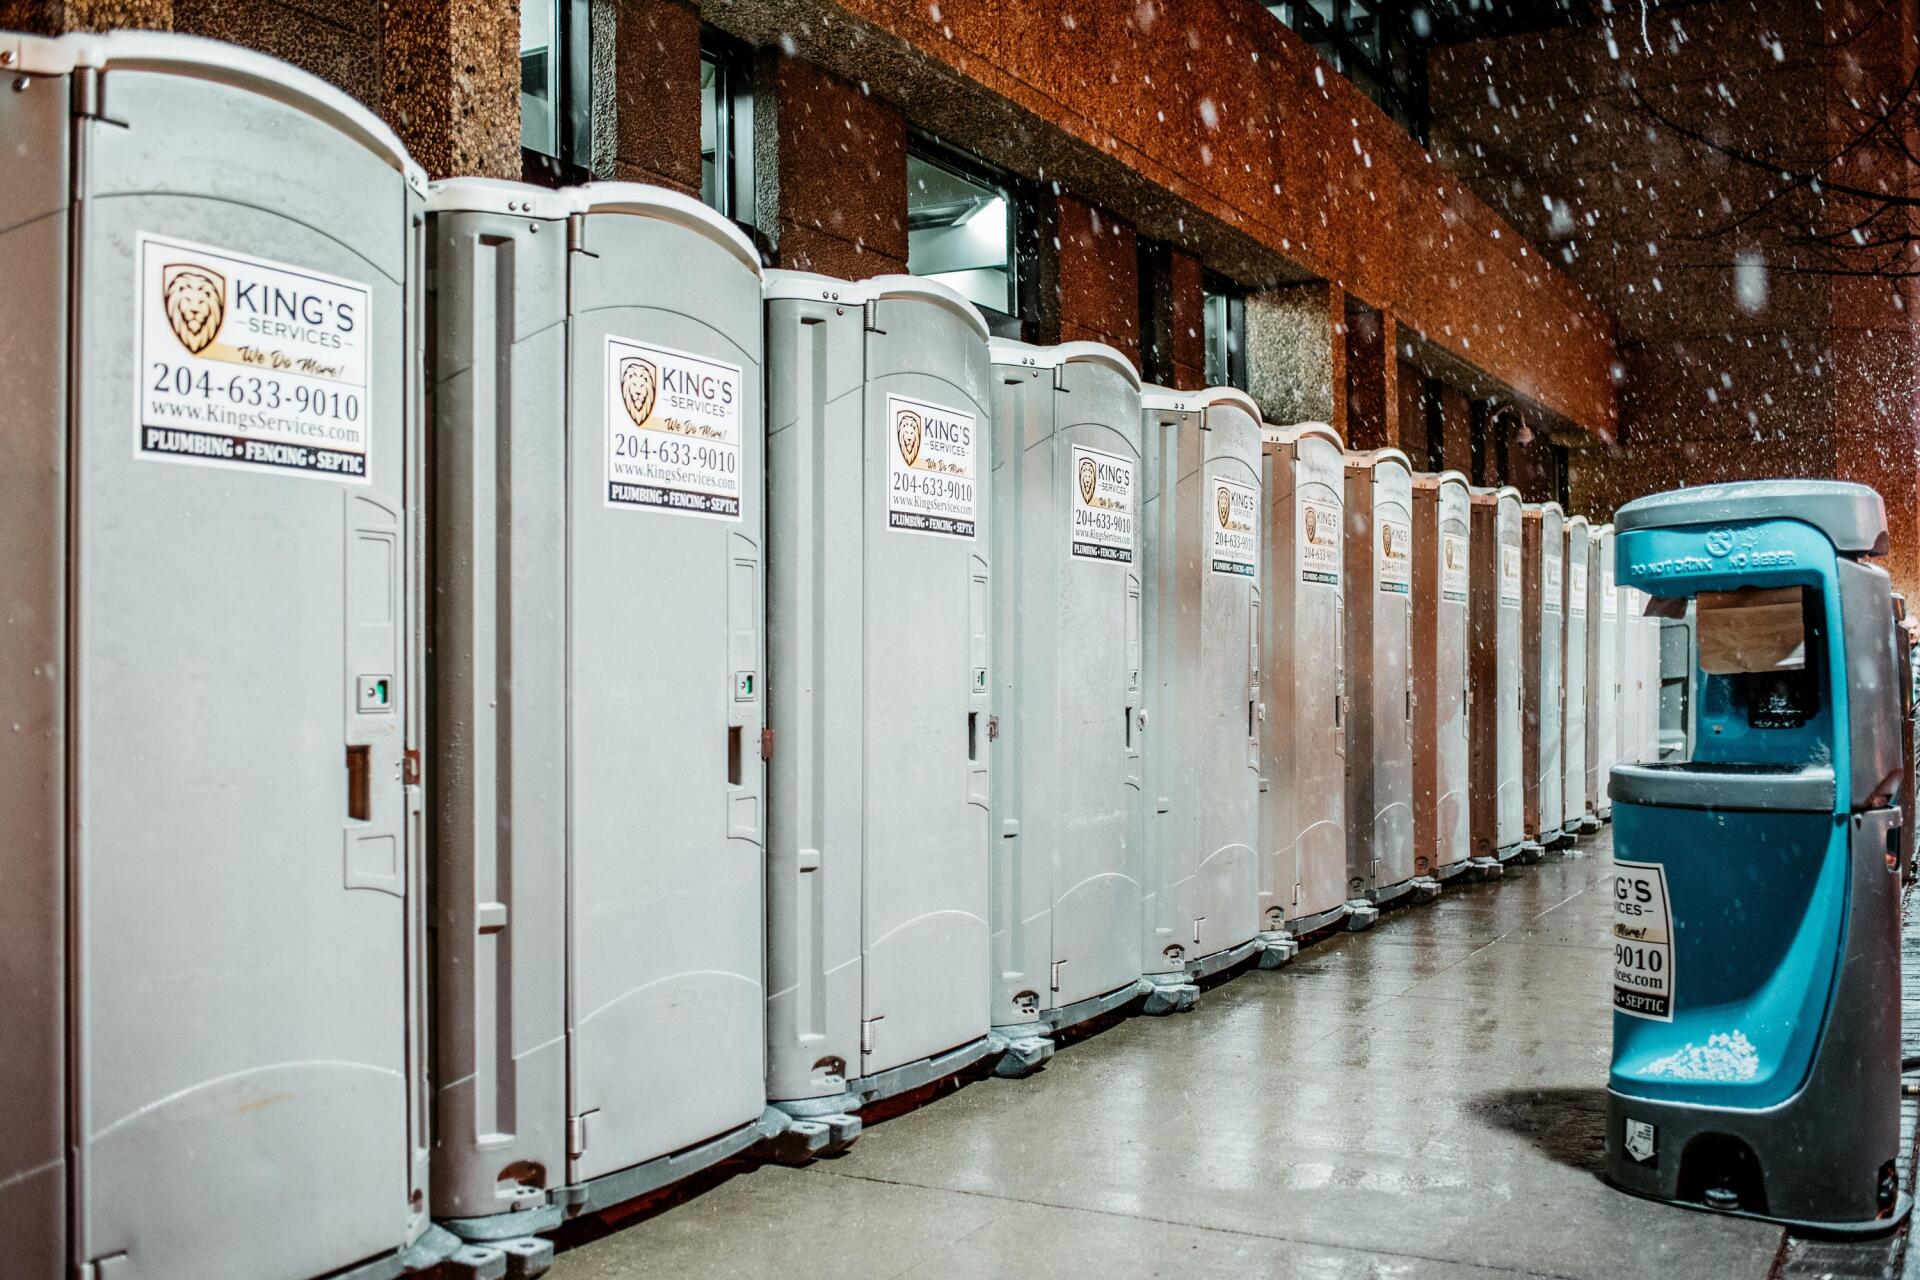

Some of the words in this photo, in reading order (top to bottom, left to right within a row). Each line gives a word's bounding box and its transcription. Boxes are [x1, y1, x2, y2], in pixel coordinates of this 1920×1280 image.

[236, 280, 354, 332] KING'S
[248, 318, 342, 350] SERVICES
[238, 345, 265, 364] We
[271, 351, 291, 369] Do
[297, 358, 345, 378] More!
[153, 362, 358, 421] 204-633-9010
[663, 367, 732, 404] KING'S
[671, 396, 725, 417] SERVICES
[152, 400, 360, 443] www.KingsServices.com
[665, 418, 681, 431] We
[684, 420, 697, 435] Do
[700, 425, 727, 439] More!
[925, 417, 970, 446] KING'S
[147, 429, 233, 457] PLUMBING
[245, 441, 308, 465] FENCING
[317, 452, 364, 474] SEPTIC
[615, 434, 735, 474] 204-633-9010
[930, 441, 965, 457] SERVICES
[614, 461, 736, 490] www.KingsServices.com
[939, 460, 947, 472] Do
[1098, 463, 1129, 486] KING'S
[612, 485, 662, 503] PLUMBING
[669, 493, 706, 509] FENCING
[711, 498, 737, 513] SEPTIC
[894, 472, 972, 502] 204-633-9010
[1102, 482, 1126, 495] SERVICES
[893, 495, 973, 515] www.KingsServices.com
[892, 513, 925, 528] PLUMBING
[929, 518, 953, 532] FENCING
[956, 523, 974, 534] SEPTIC
[1076, 509, 1130, 533] 204-633-9010
[1631, 564, 1646, 575] DO
[1648, 559, 1672, 574] NOT
[1675, 556, 1713, 573] DRINK
[1729, 553, 1747, 569] NO
[1751, 550, 1796, 567] BEBER
[1614, 877, 1652, 902] G'S
[1615, 902, 1642, 916] ICES
[1626, 994, 1664, 1012] SEPTIC
